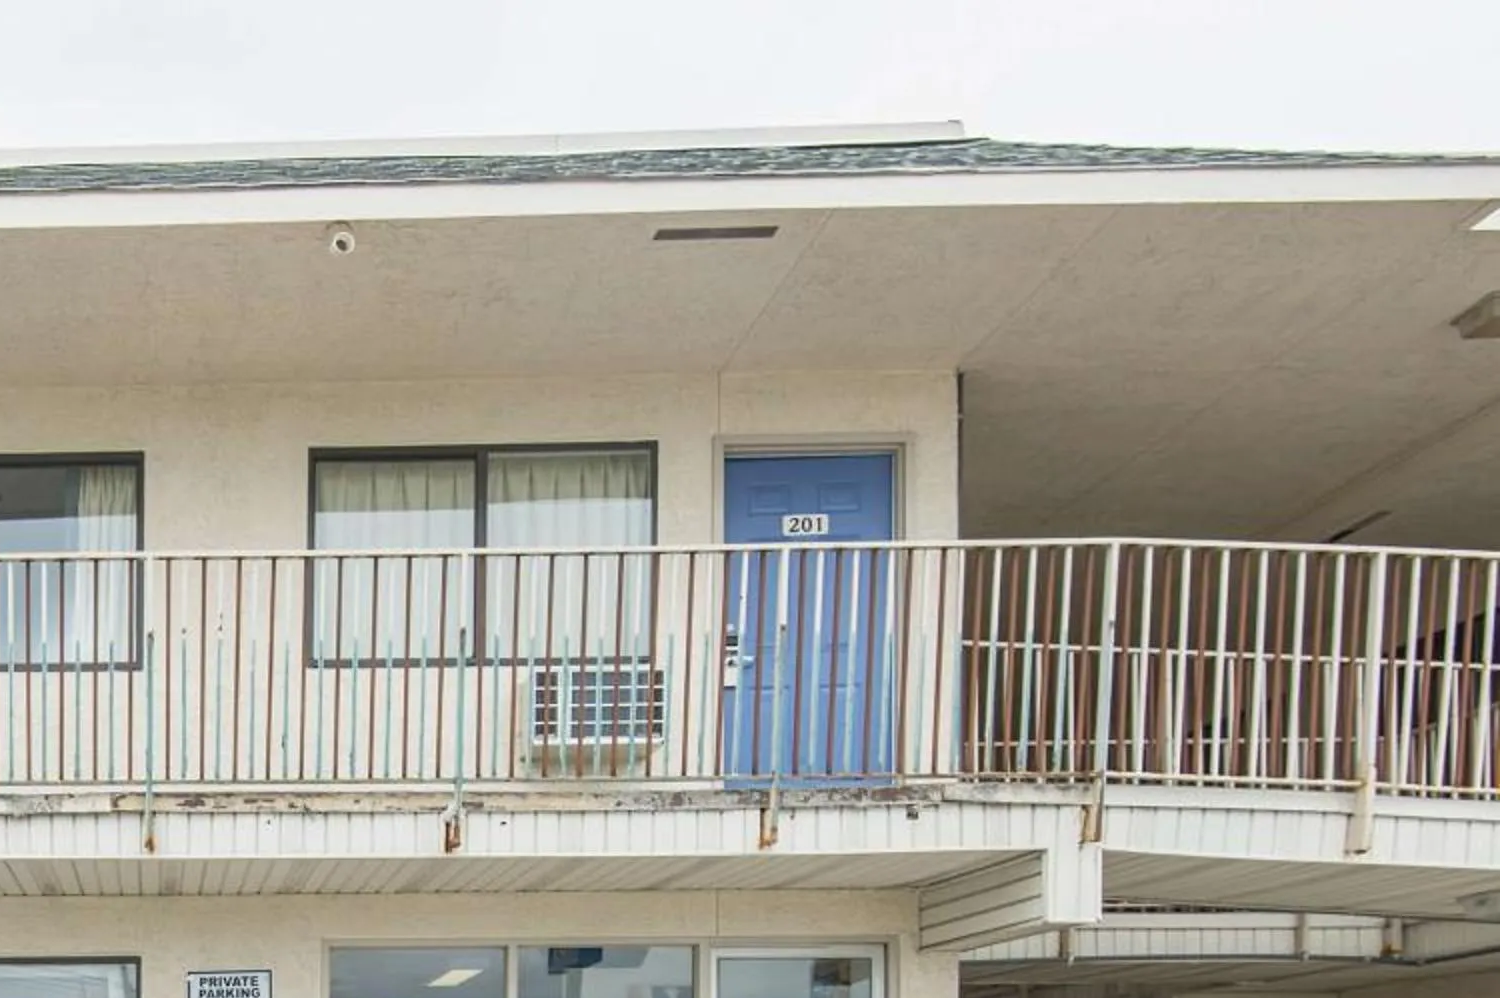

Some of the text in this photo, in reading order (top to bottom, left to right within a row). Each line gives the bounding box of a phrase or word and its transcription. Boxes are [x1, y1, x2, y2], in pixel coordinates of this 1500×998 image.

[790, 517, 822, 533] 201
[199, 975, 259, 987] PRIVATE
[199, 987, 261, 998] PARKING
